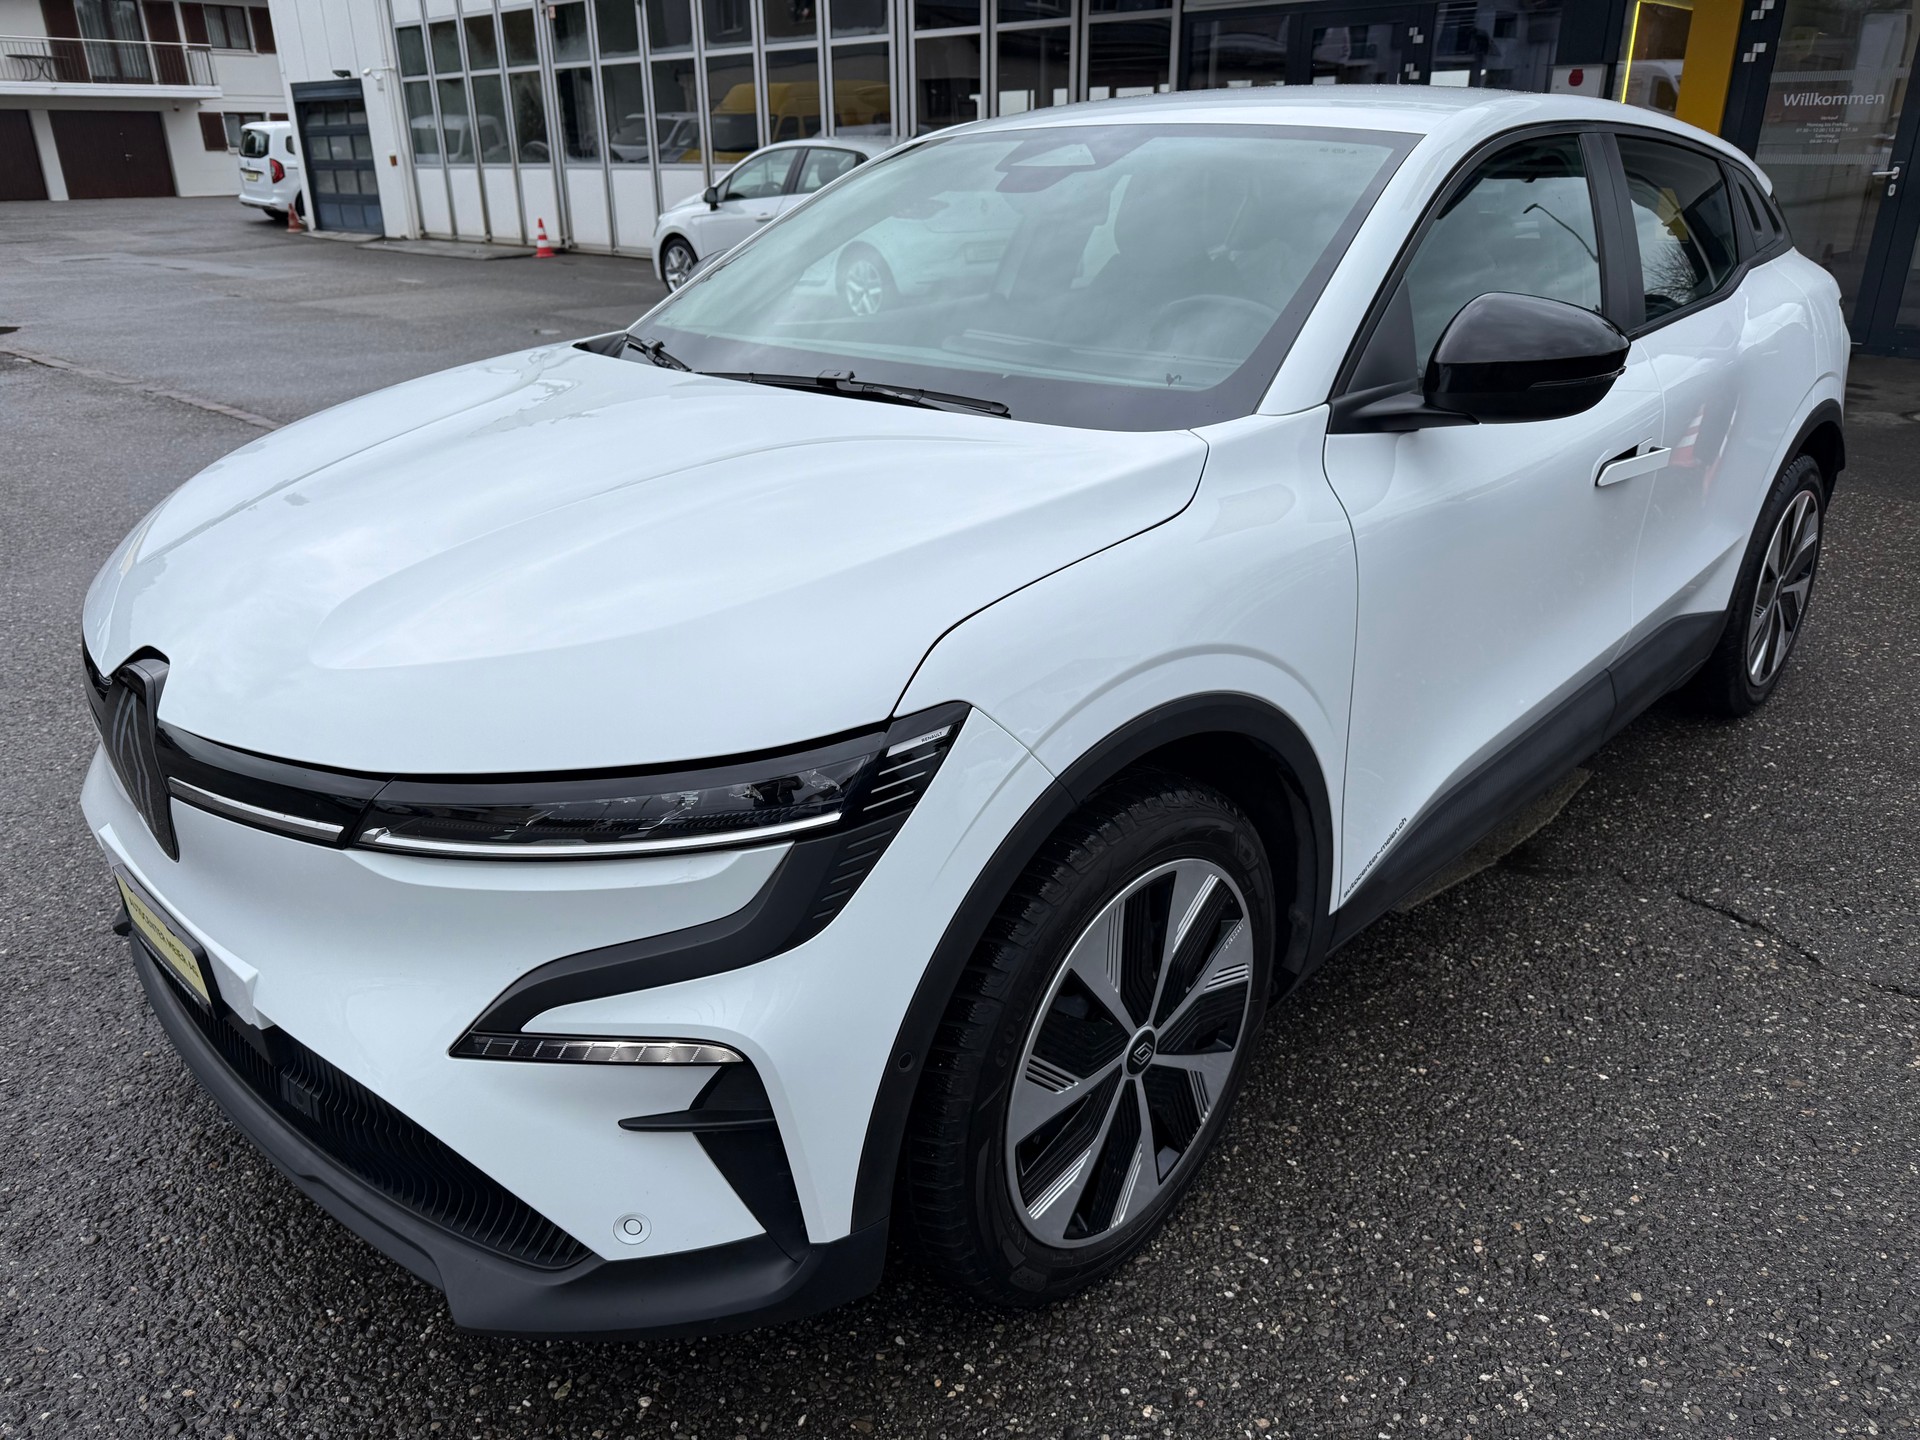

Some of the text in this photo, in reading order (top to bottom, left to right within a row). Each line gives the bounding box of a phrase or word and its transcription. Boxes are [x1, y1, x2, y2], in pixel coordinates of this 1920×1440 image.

[1783, 92, 1885, 106] Willkommen
[921, 731, 942, 742] RENAULT
[1343, 817, 1407, 898] autocenter-meier.ch
